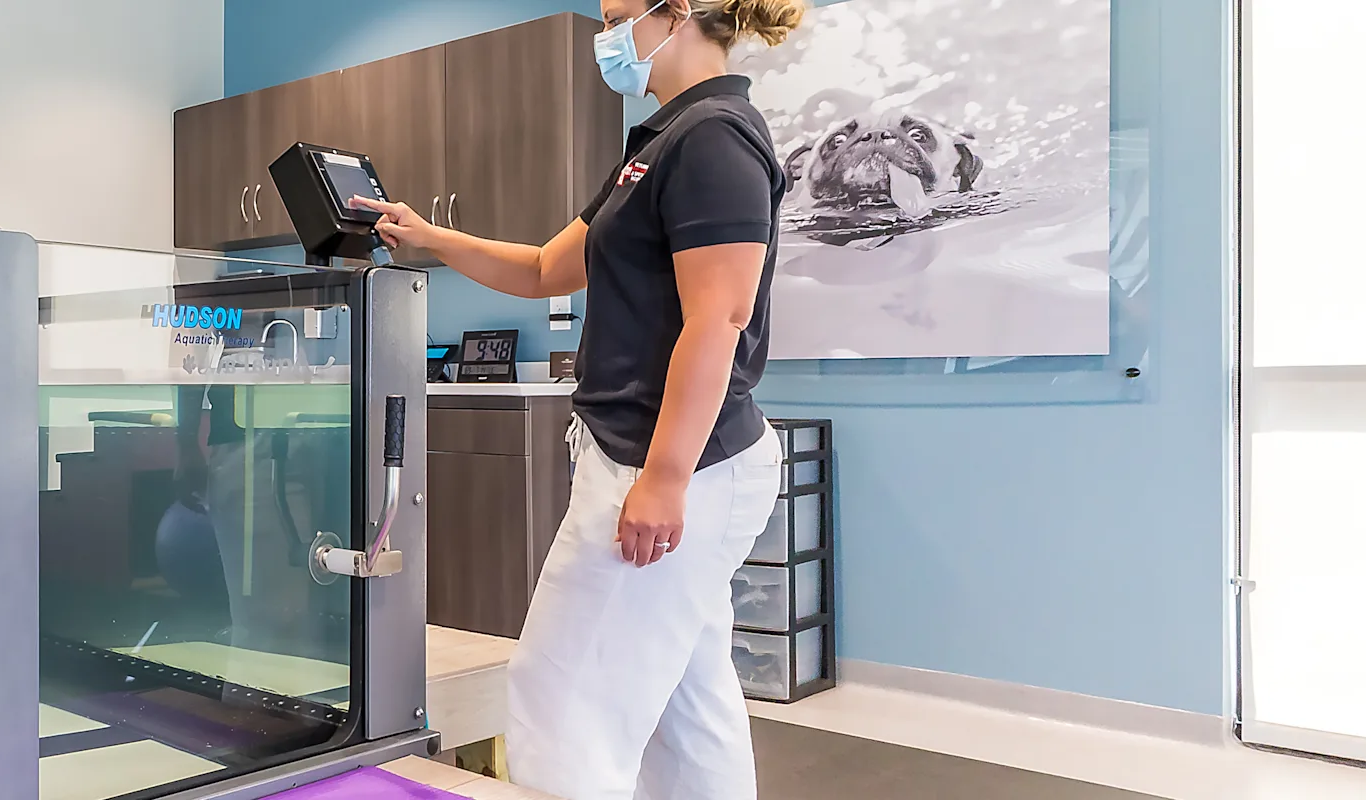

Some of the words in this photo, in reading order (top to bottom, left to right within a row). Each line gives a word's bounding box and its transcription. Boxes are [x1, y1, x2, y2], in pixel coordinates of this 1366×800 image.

[151, 303, 243, 330] HUDSON
[174, 332, 213, 347] Aquatic
[476, 340, 512, 361] 9:48
